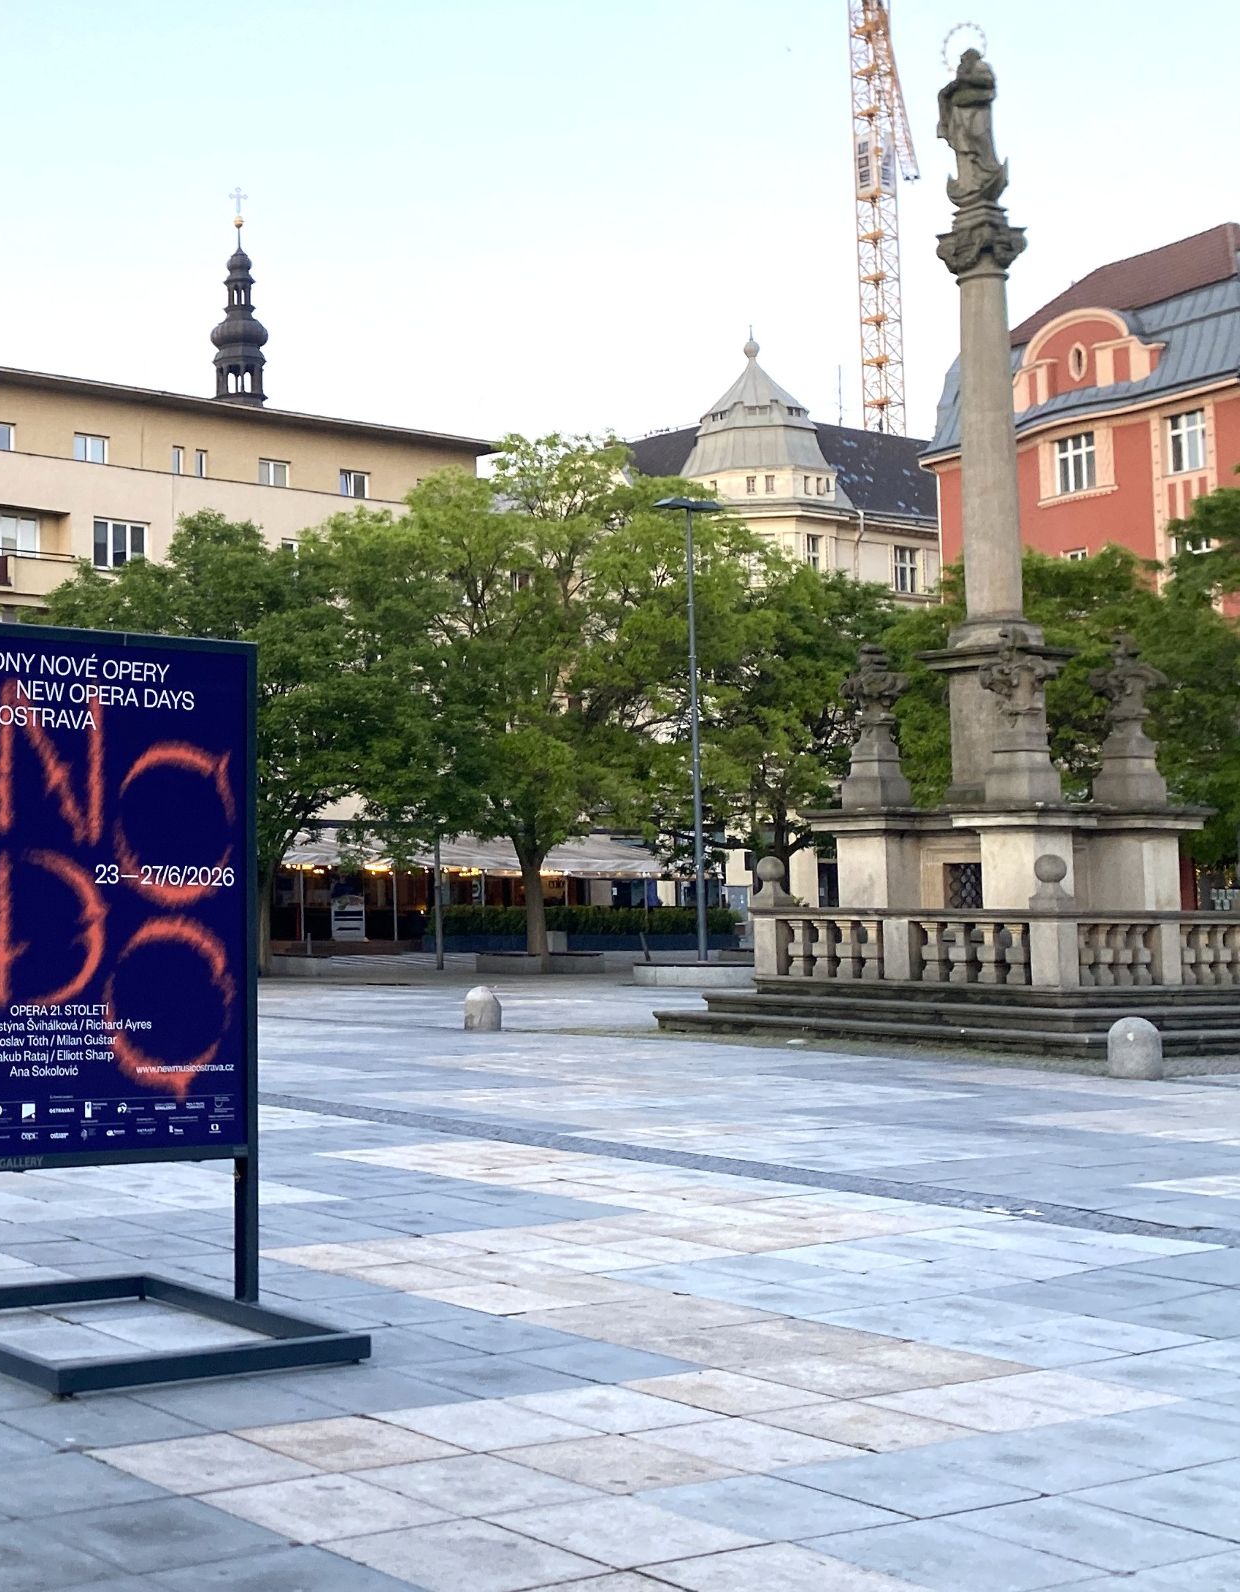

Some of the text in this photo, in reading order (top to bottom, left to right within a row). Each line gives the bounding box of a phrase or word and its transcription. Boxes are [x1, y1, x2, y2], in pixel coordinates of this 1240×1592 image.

[40, 654, 98, 678] NOVÉ
[103, 659, 170, 683] OPERY
[16, 680, 195, 711] NEW OPERA DAYS
[10, 1002, 109, 1016] OPERA 21. STOLETÍ
[26, 1018, 78, 1031] Švihálková
[86, 1018, 123, 1031] Richard
[124, 1018, 152, 1031] Ayres
[26, 1035, 49, 1047] Tóth
[56, 1034, 82, 1046] Milan
[84, 1034, 117, 1046] Guštar
[23, 1050, 49, 1064] Rataj
[56, 1049, 83, 1061] Elliott
[85, 1049, 115, 1062] Sharp
[9, 1064, 79, 1077] Ana Sokolović
